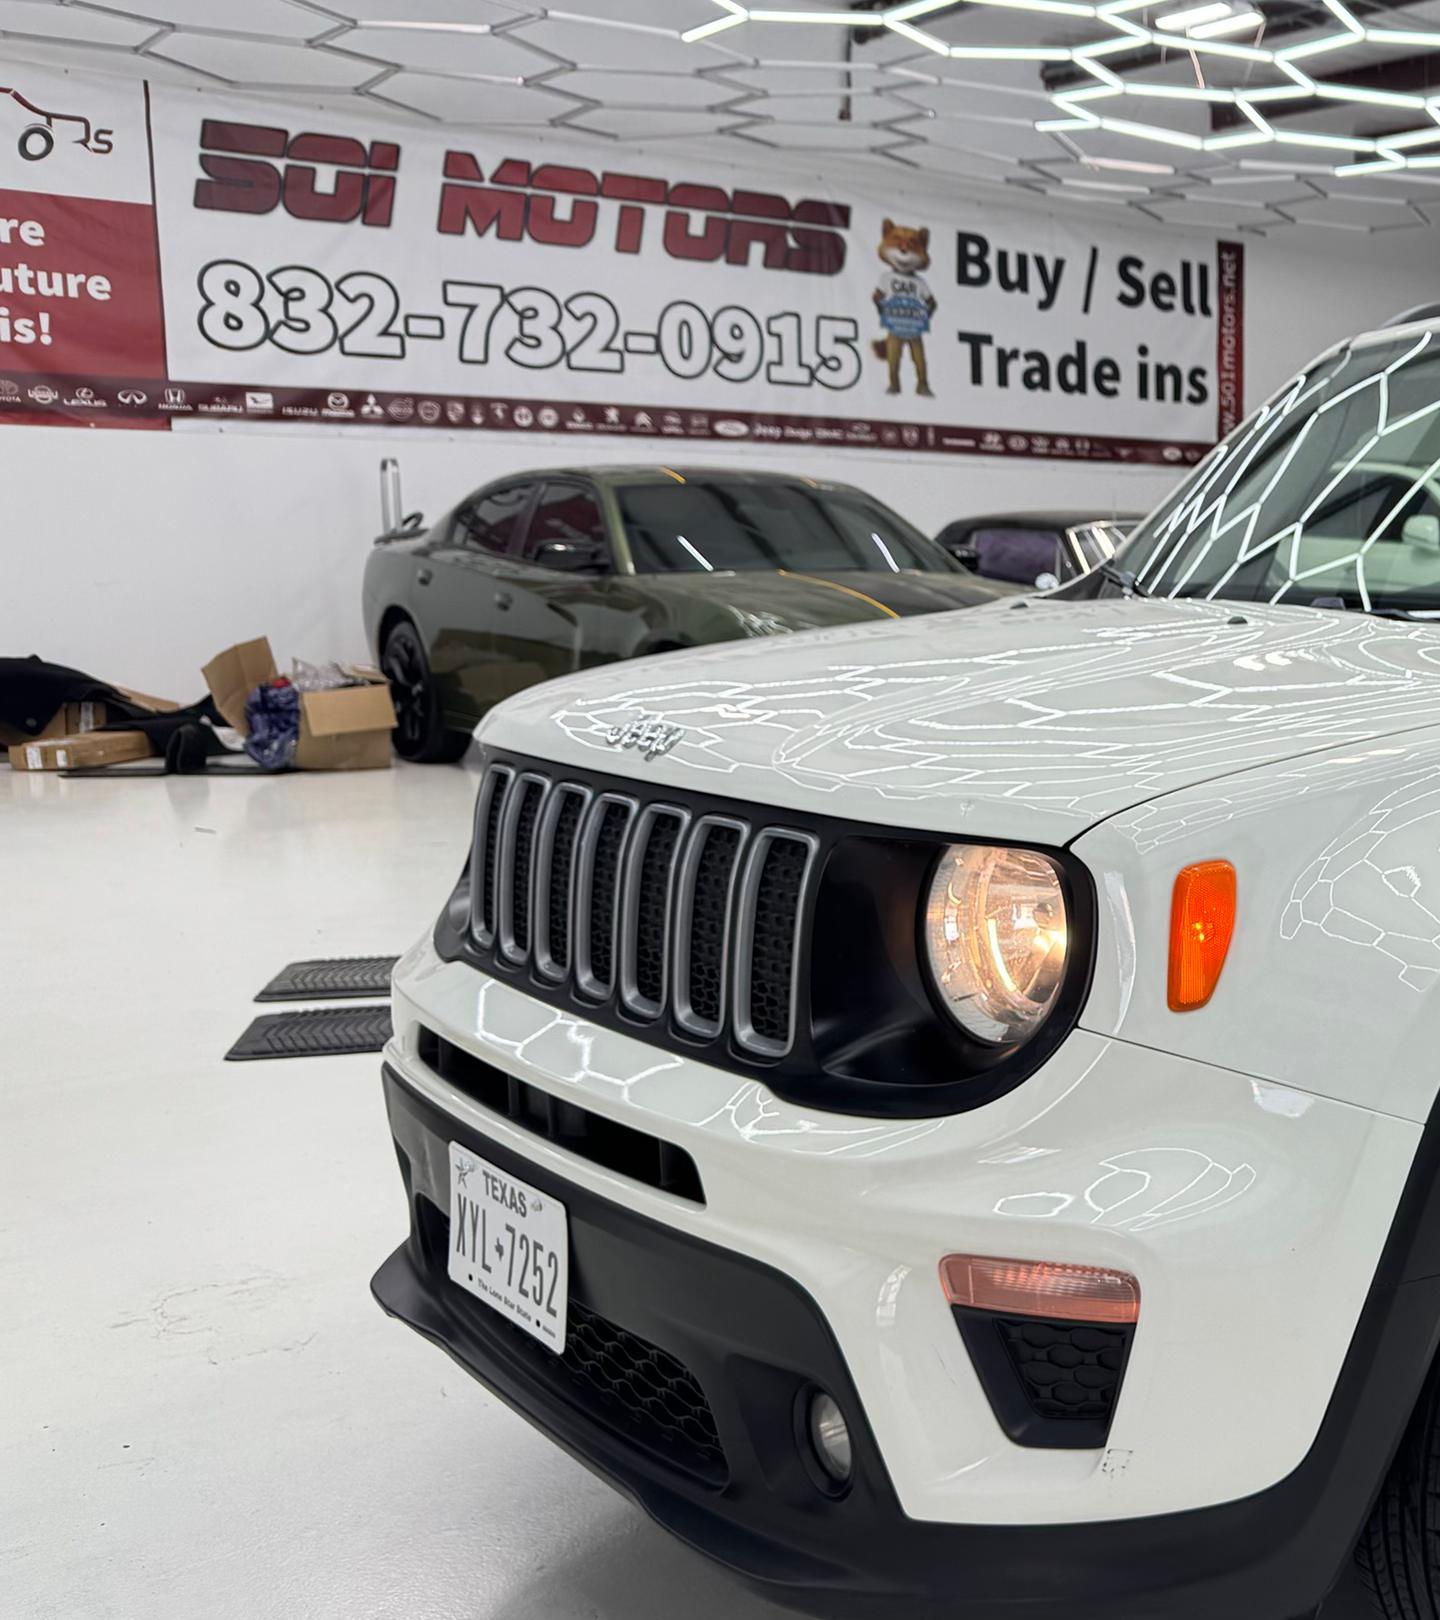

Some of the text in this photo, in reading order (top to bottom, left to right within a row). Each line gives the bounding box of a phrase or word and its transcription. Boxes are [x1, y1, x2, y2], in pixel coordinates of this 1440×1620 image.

[437, 150, 852, 277] MOTORS
[956, 231, 1066, 312] Buy
[1116, 255, 1213, 318] Sell
[198, 259, 862, 391] 832-732-0915
[958, 332, 1209, 406] Trade ins
[482, 1170, 528, 1219] TEXAS
